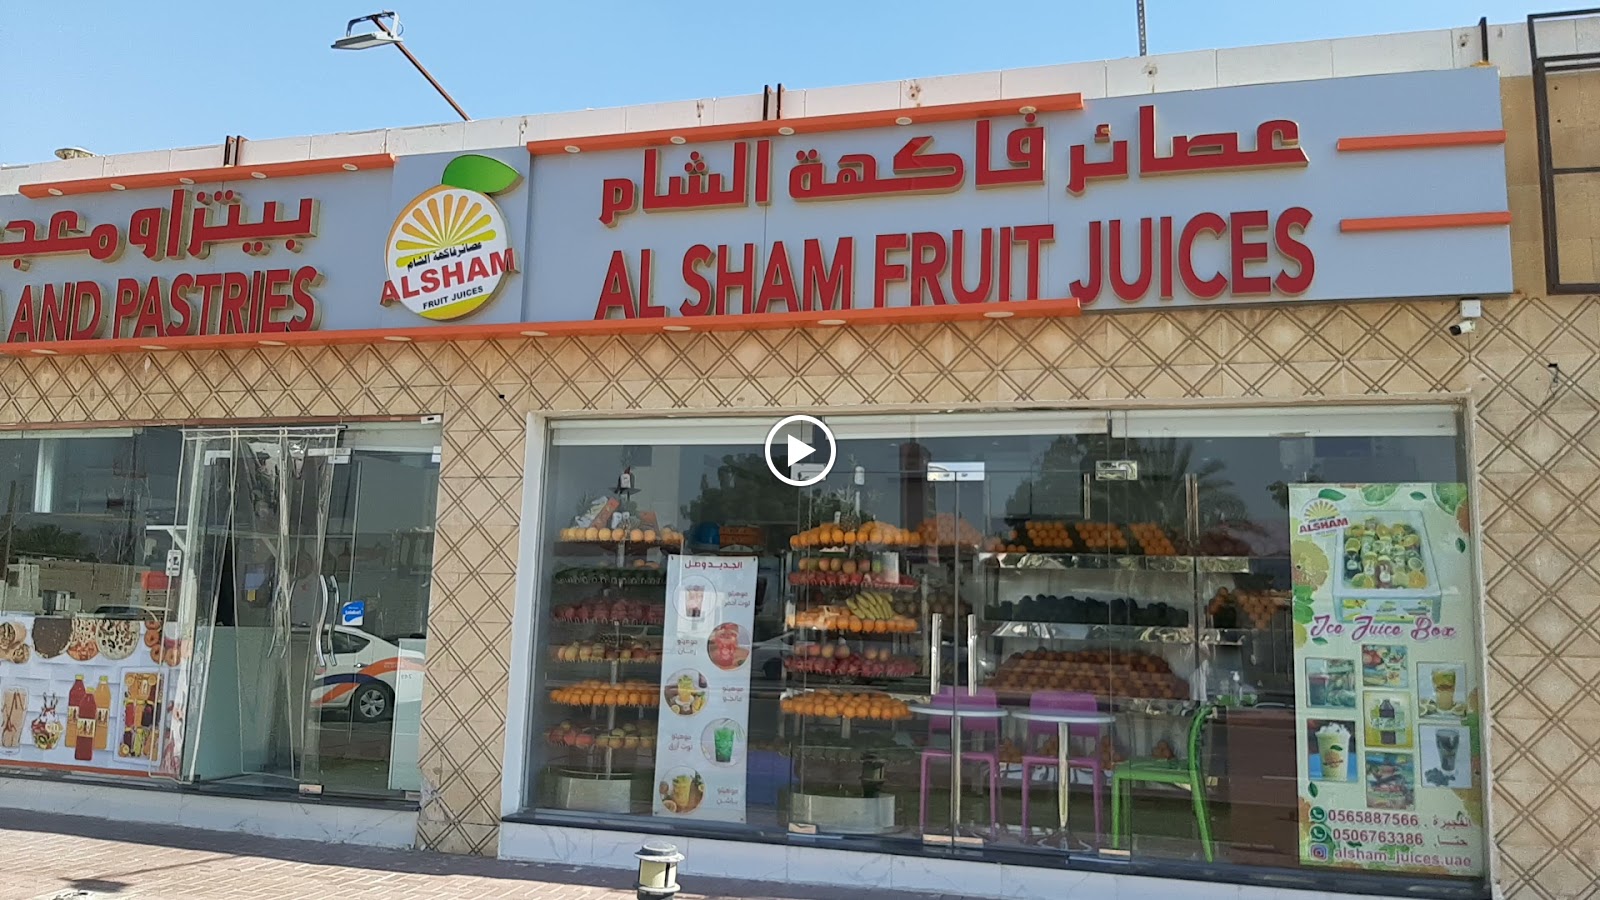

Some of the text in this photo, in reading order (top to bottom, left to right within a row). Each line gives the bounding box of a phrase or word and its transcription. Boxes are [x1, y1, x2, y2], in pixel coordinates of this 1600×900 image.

[599, 105, 1310, 228] عصائر فاكهة الشام
[594, 206, 1316, 320] AL SHAM FRUIT JUICES
[380, 247, 515, 306] ALSHAM
[6, 265, 322, 343] AND PASTRIES
[423, 285, 484, 310] FRUIT JUICES
[1299, 517, 1349, 533] ALSHAM
[1310, 615, 1457, 641] Ice Juice Box
[1328, 809, 1419, 827] 0565887566
[1332, 828, 1424, 846] 0506763386
